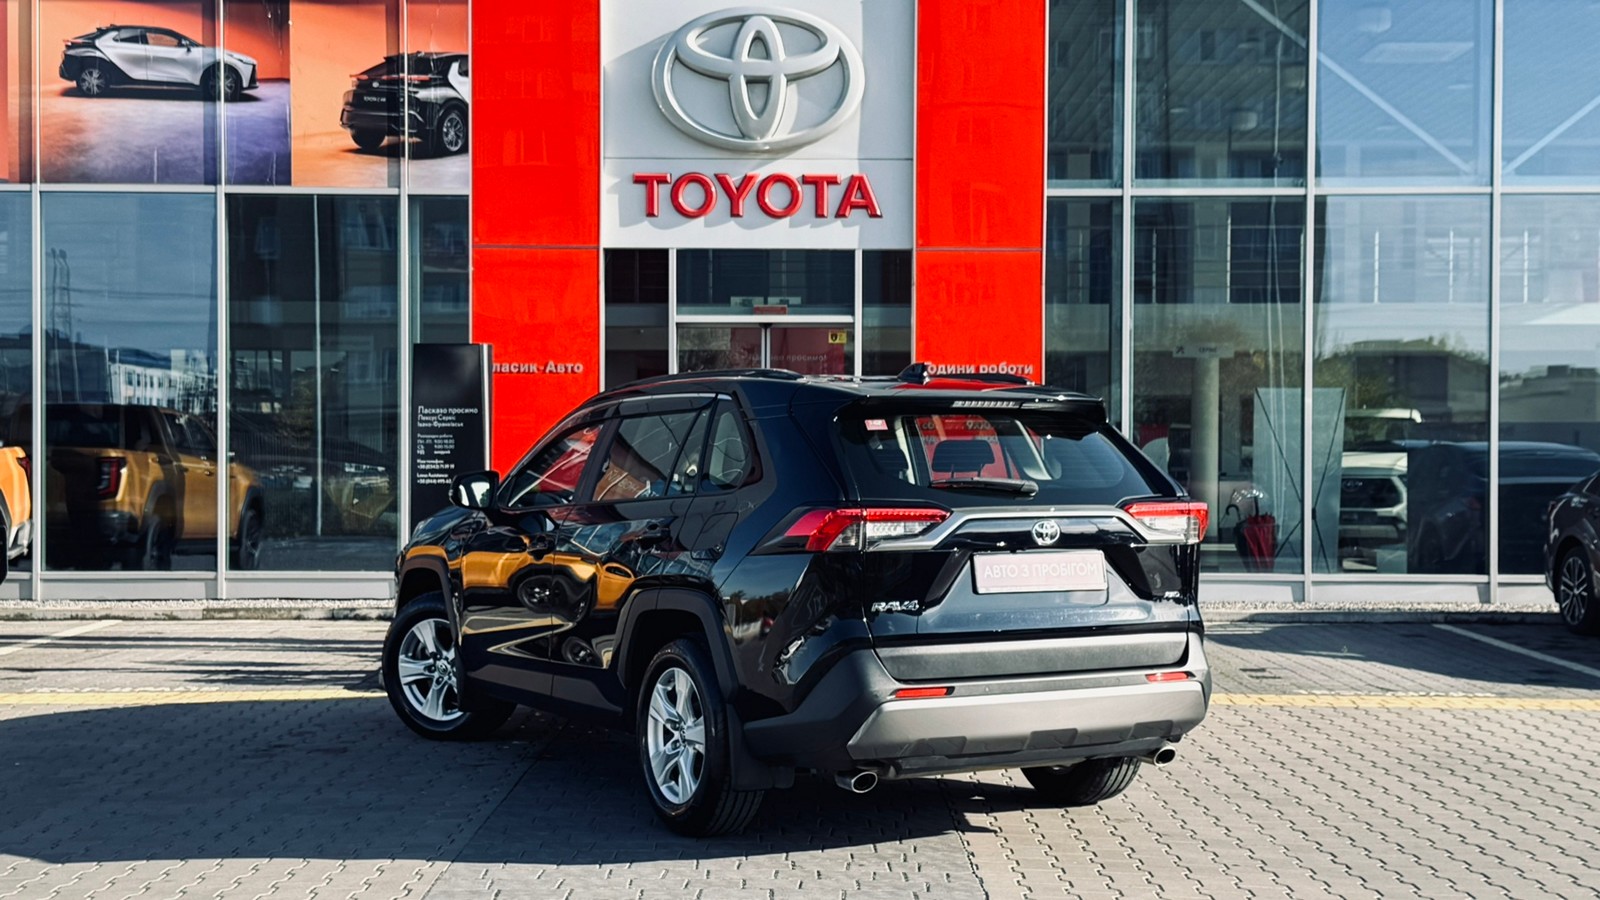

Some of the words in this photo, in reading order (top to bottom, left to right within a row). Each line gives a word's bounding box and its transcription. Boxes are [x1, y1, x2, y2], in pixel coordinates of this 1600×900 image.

[632, 172, 883, 218] TOYOTA
[492, 360, 584, 373] ласик-Авто
[448, 407, 479, 415] просимо
[984, 564, 1018, 579] АВТО
[1022, 564, 1030, 578] З
[1033, 562, 1098, 577] ПРОБІГОМ
[871, 600, 919, 612] RAV4
